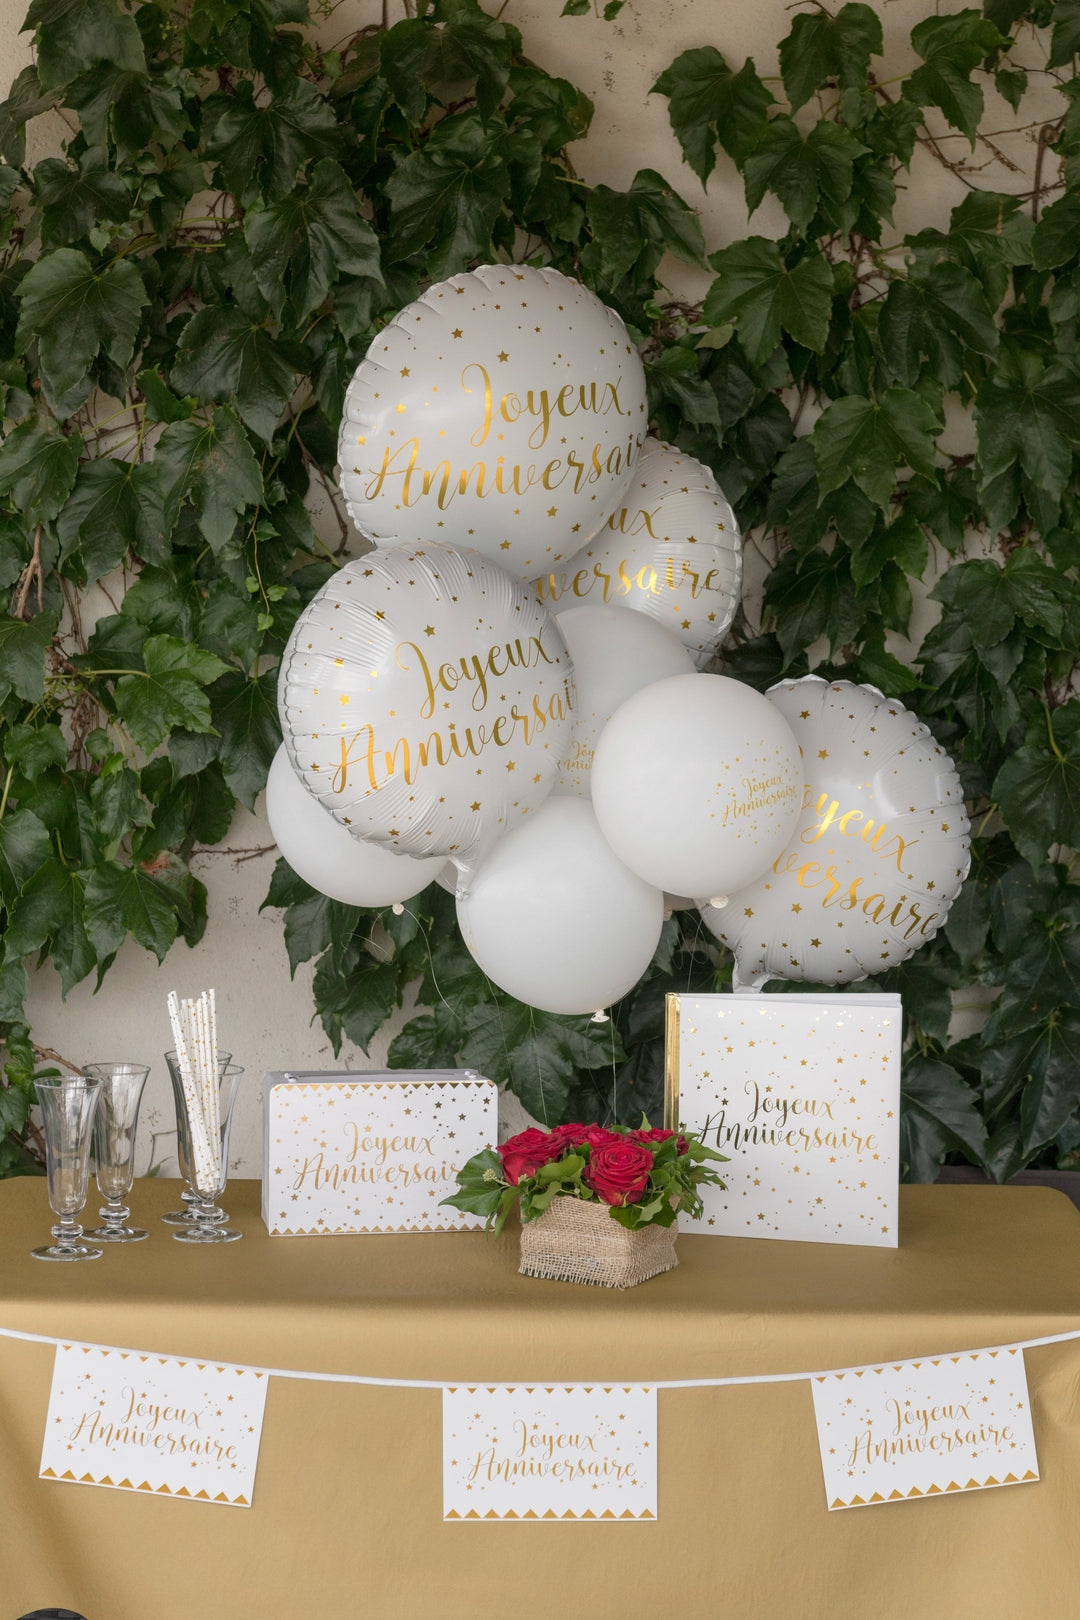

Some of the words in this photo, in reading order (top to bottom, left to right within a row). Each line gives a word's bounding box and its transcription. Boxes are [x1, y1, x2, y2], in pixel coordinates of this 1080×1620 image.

[461, 363, 627, 450] Joyeux
[395, 626, 554, 720] Joyeux
[328, 677, 574, 794] Anniversai
[742, 776, 784, 801] Joyeux
[773, 848, 939, 940] versaire
[744, 1079, 837, 1128] Joyeux
[343, 1121, 437, 1166] Joyeux
[697, 1110, 879, 1155] Anniversaire
[121, 1385, 204, 1431] Joyeux
[885, 1398, 971, 1436] Joyeux
[69, 1410, 238, 1462] Anniversaire
[513, 1419, 598, 1461] Joyeux
[848, 1424, 1014, 1467] Anniversaire
[467, 1447, 637, 1482] Anniversaire
